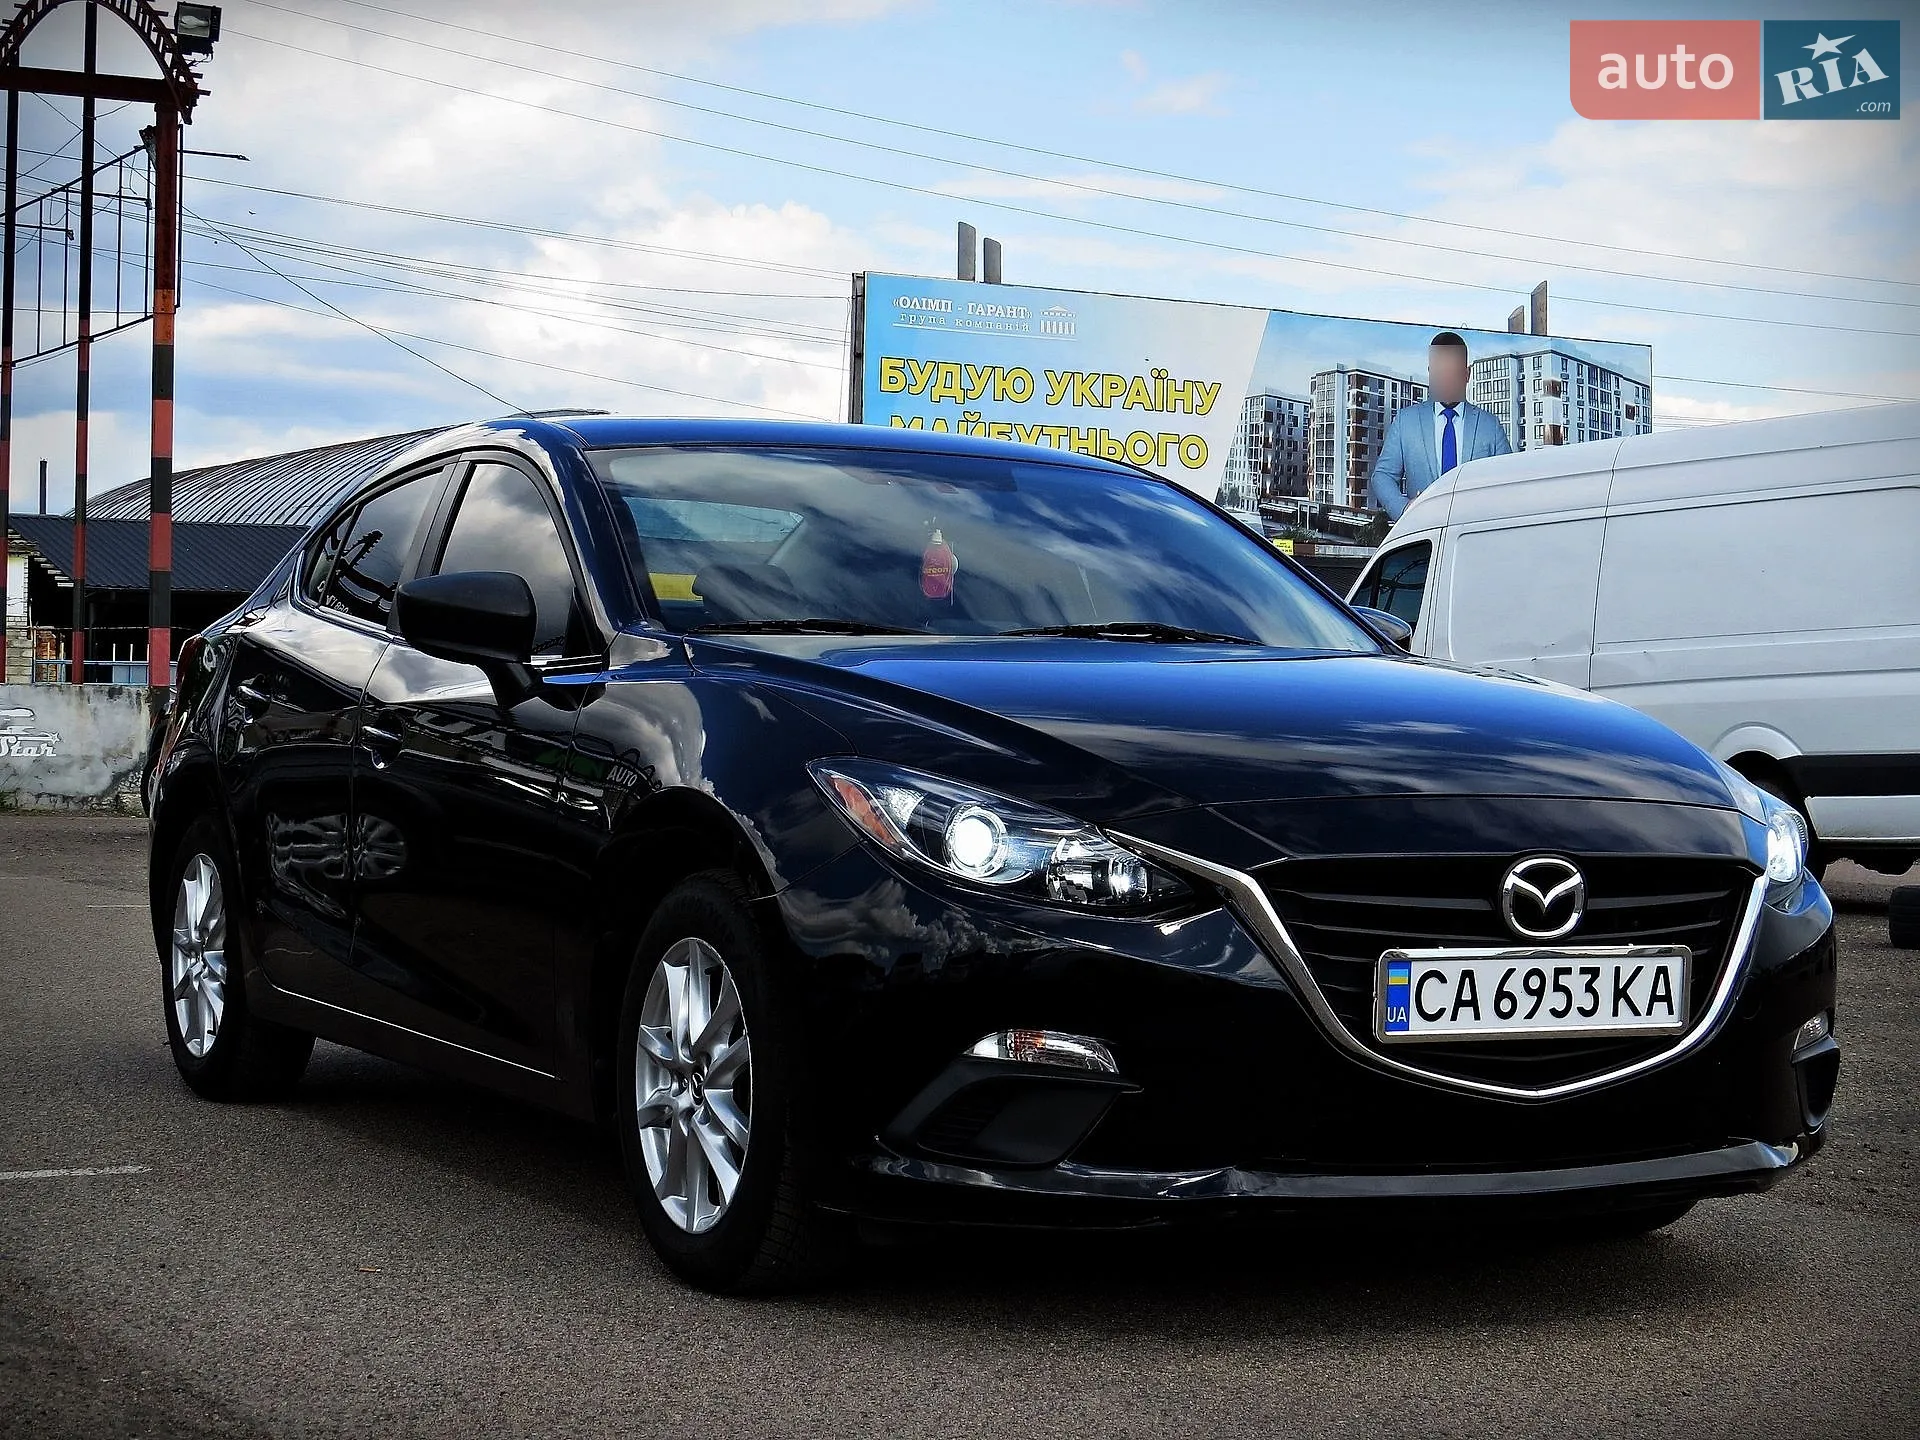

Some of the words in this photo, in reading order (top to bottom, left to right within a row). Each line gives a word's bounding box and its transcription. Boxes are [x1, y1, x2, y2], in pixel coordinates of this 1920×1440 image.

[899, 311, 947, 326] група
[954, 317, 1032, 333] компаній
[879, 356, 1035, 405] БУДУЮ
[1043, 367, 1222, 416] УКРАЇНУ
[1413, 968, 1482, 1023] CA
[1492, 965, 1602, 1021] 6953
[1610, 964, 1676, 1018] KA
[1386, 1005, 1408, 1024] UA
